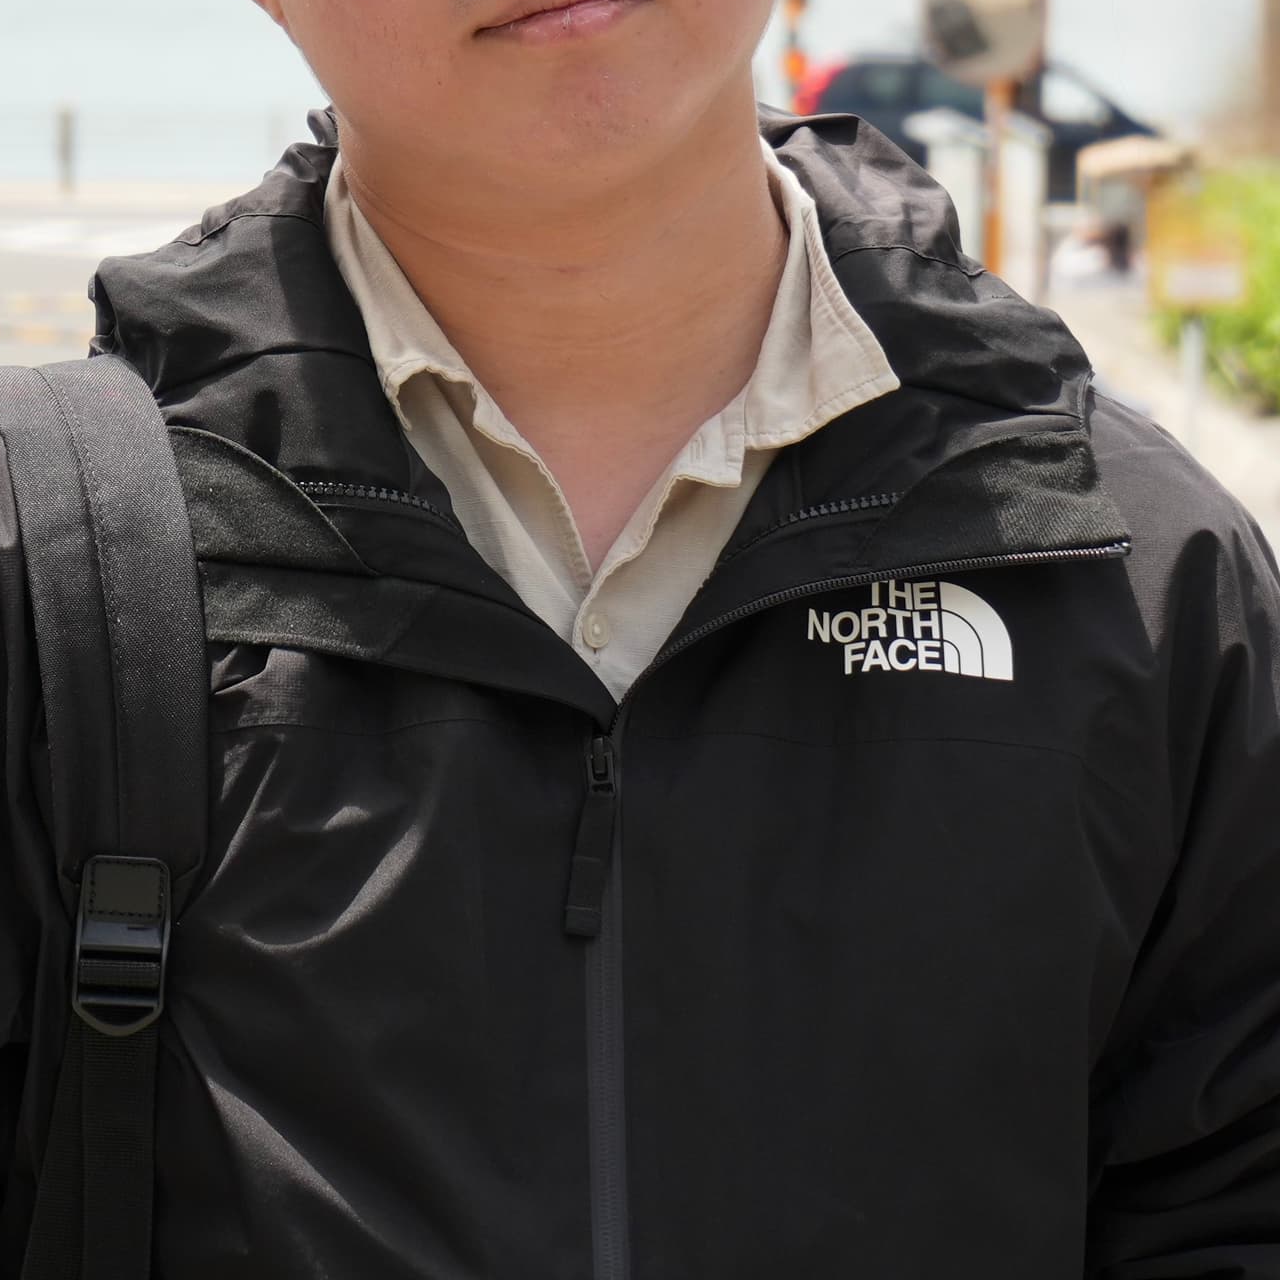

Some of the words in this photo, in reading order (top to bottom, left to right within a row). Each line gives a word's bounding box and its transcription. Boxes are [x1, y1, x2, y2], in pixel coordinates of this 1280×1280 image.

[872, 579, 938, 610] THE
[807, 608, 941, 643] NORTH
[844, 638, 942, 675] FACE
